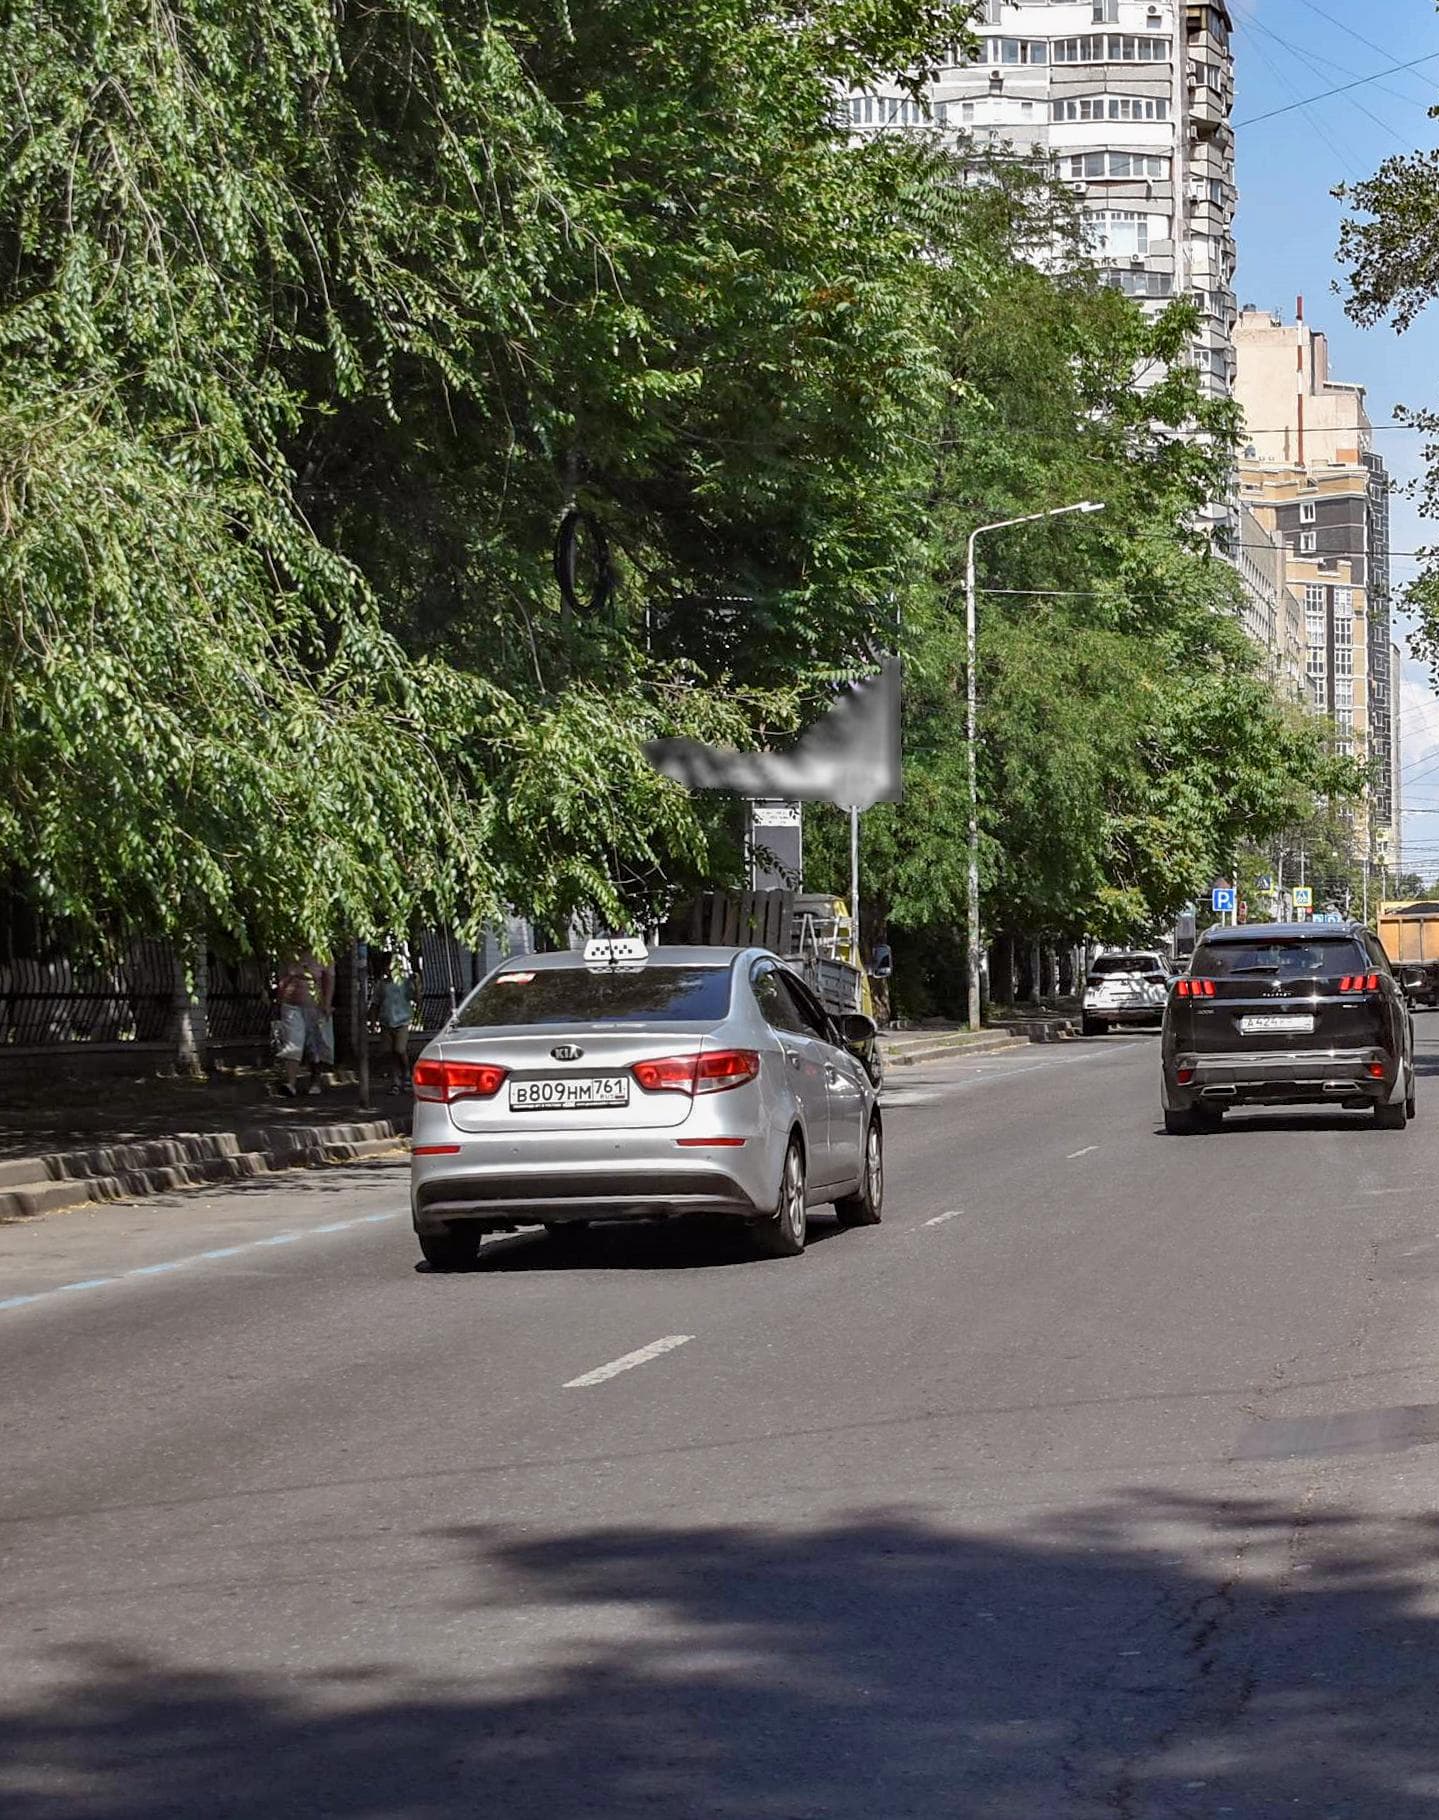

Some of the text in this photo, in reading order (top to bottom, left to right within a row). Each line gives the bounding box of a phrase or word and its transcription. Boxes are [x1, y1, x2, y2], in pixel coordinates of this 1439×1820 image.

[1218, 892, 1230, 908] P
[555, 1047, 579, 1059] KIA
[517, 1079, 623, 1102] В809НМ 761
